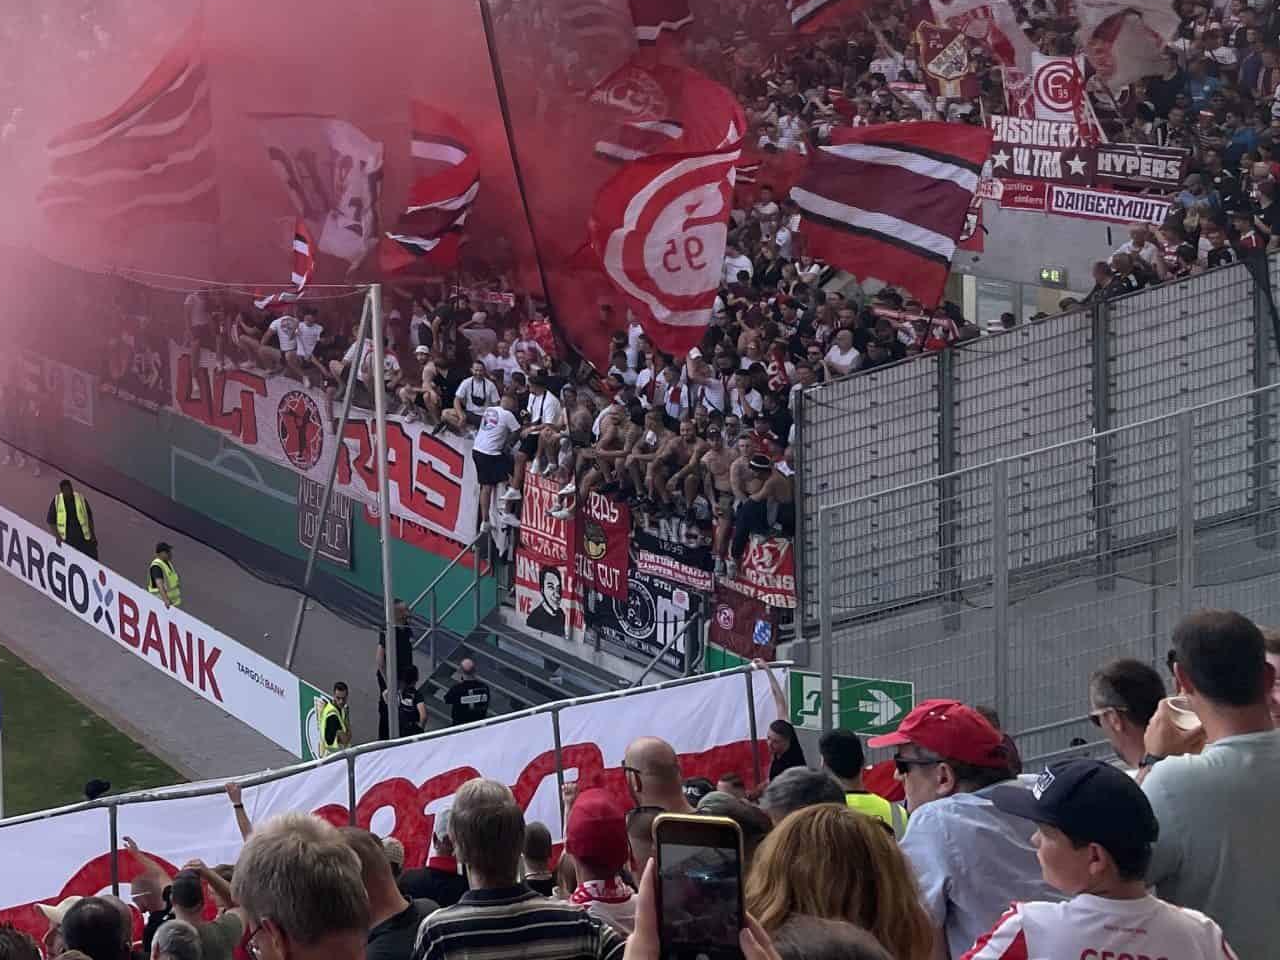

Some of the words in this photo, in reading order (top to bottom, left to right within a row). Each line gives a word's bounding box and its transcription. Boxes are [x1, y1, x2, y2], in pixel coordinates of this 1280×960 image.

[1013, 147, 1063, 179] ULTRA
[1097, 151, 1182, 180] HYPERS
[1054, 190, 1173, 224] DANGERMOUT
